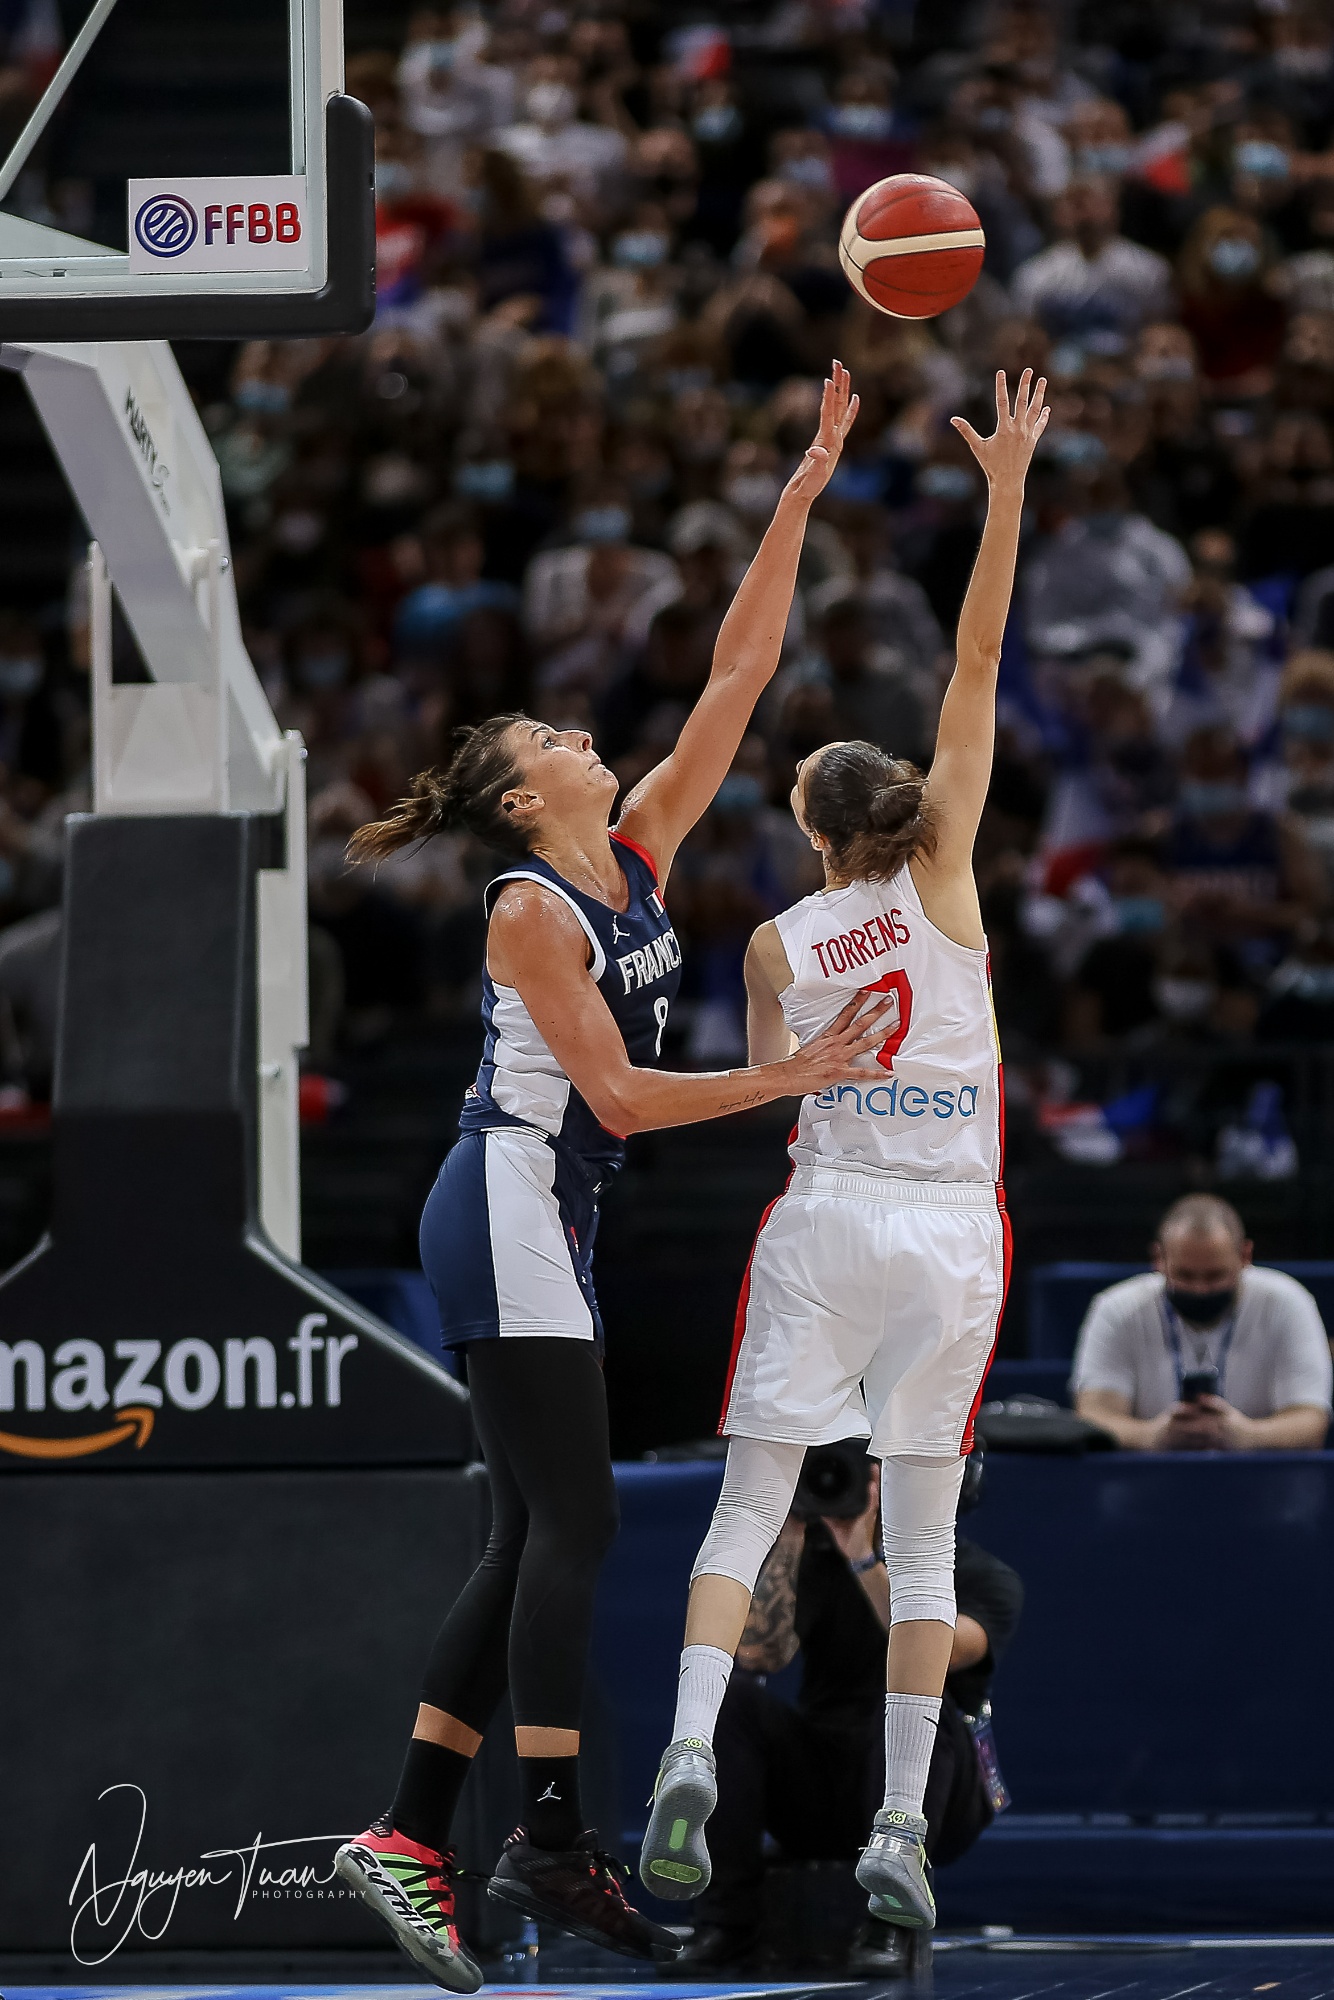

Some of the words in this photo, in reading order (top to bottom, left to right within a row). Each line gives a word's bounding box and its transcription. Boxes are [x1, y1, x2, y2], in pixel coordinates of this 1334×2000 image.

[204, 203, 301, 245] FFBB
[616, 927, 683, 995] FRANC
[811, 908, 911, 978] TORRENS
[859, 968, 914, 1071] 7
[814, 1079, 979, 1119] endesa
